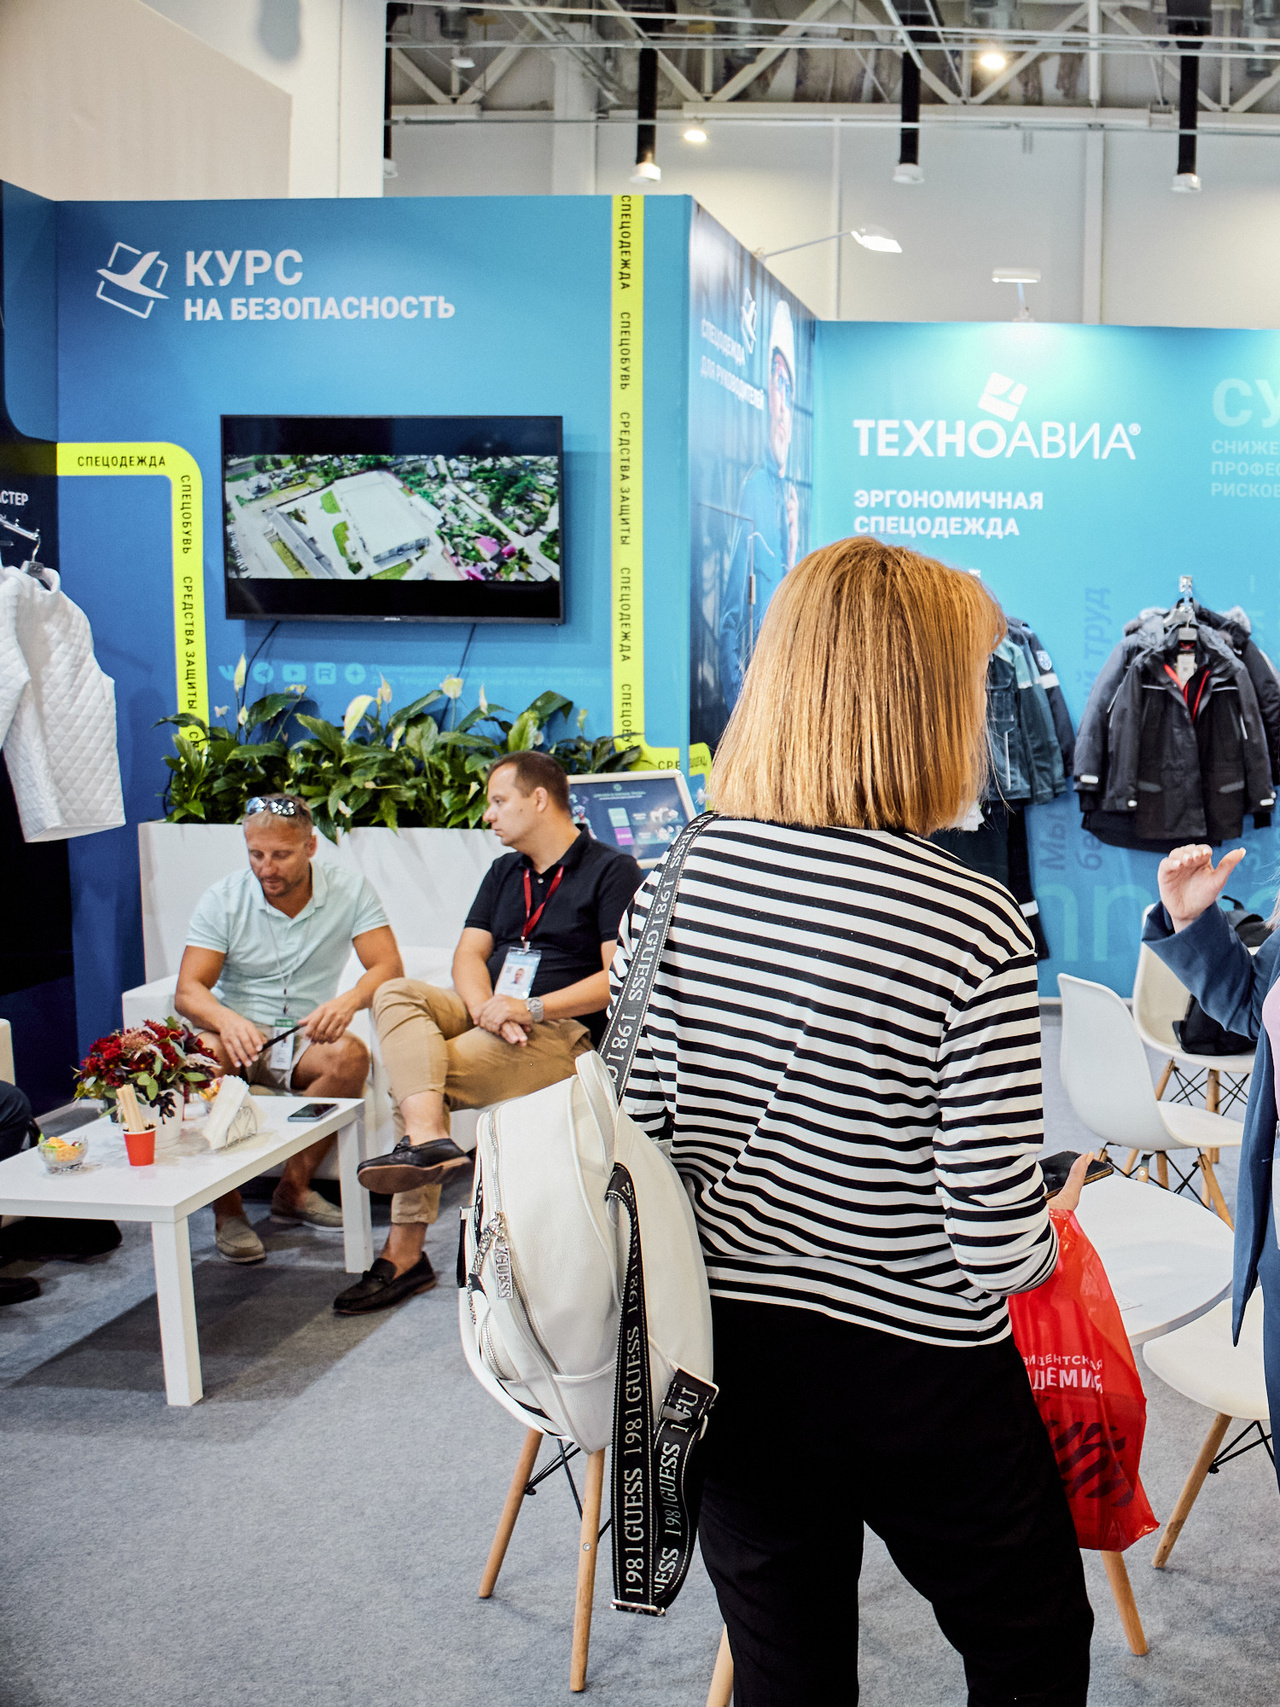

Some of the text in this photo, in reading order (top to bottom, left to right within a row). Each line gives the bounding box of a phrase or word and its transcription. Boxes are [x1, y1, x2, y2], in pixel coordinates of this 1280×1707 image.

[617, 195, 632, 290] СПЕЦОДЕЖДА
[185, 249, 304, 287] КУРС
[184, 295, 456, 321] НА БЕЗОПАСНОСТЬ
[617, 311, 632, 391] СПЕЦОБУВЬ
[77, 455, 166, 468] СПЕЦОДЕЖДА
[618, 411, 631, 481] СРЕДСТВА
[0, 490, 29, 506] СТЕР
[618, 486, 631, 546] ЗАЩИТЫ
[853, 488, 1044, 511] ЭРГОНОМИЧНАЯ
[853, 515, 1021, 540] СПЕЦОДЕЖДА
[180, 474, 198, 710] СПЕЦОБУВЬ СРЕДСТВА ЗАЩИТЫ
[619, 567, 632, 663] СПЕЦОДЕЖДА
[1027, 1366, 1103, 1394] ДЕМИЯ
